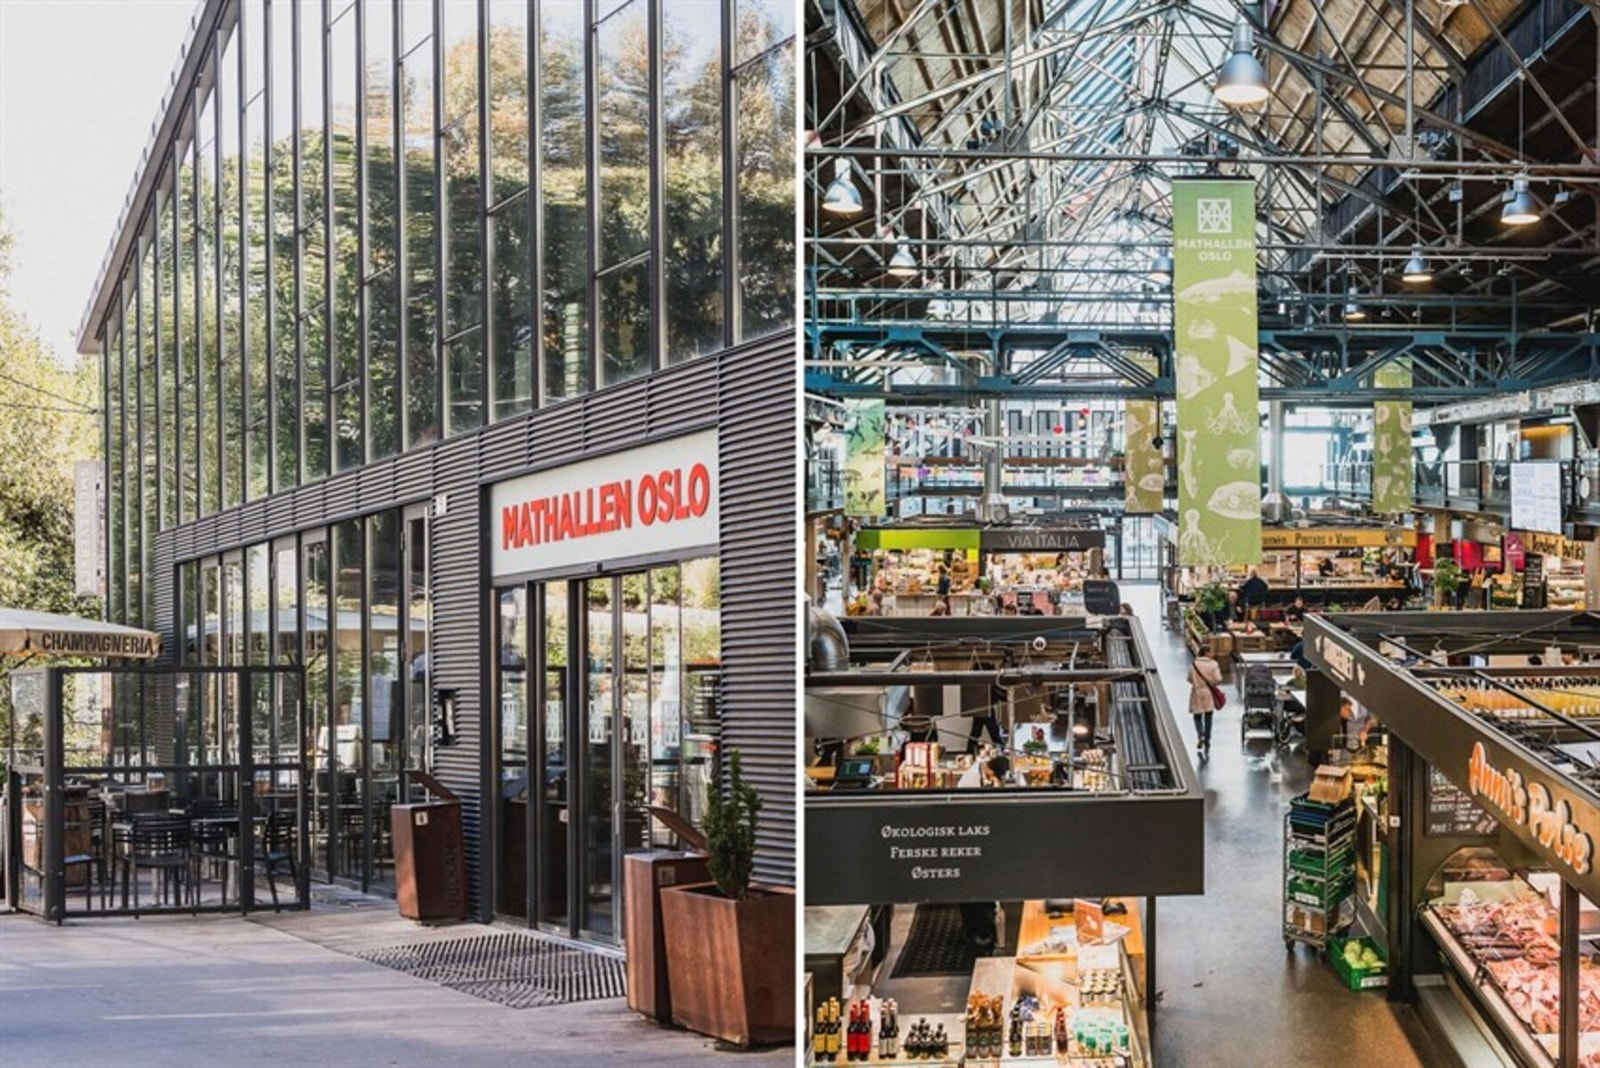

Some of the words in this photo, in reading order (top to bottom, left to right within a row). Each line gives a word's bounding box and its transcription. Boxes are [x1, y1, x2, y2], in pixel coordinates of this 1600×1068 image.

[1178, 239, 1252, 249] MATHALLEN
[1199, 251, 1232, 261] OSLO
[502, 479, 632, 551] MATHALLEN
[638, 463, 710, 526] OSLO
[1007, 535, 1032, 548] VIA
[42, 632, 156, 655] CHAMPAGNERIA
[881, 825, 955, 838] ØKOLOGISK
[959, 826, 990, 836] LAKS
[890, 846, 938, 859] FERSKE
[941, 847, 981, 858] REKER
[911, 866, 961, 879] ØSTERS
